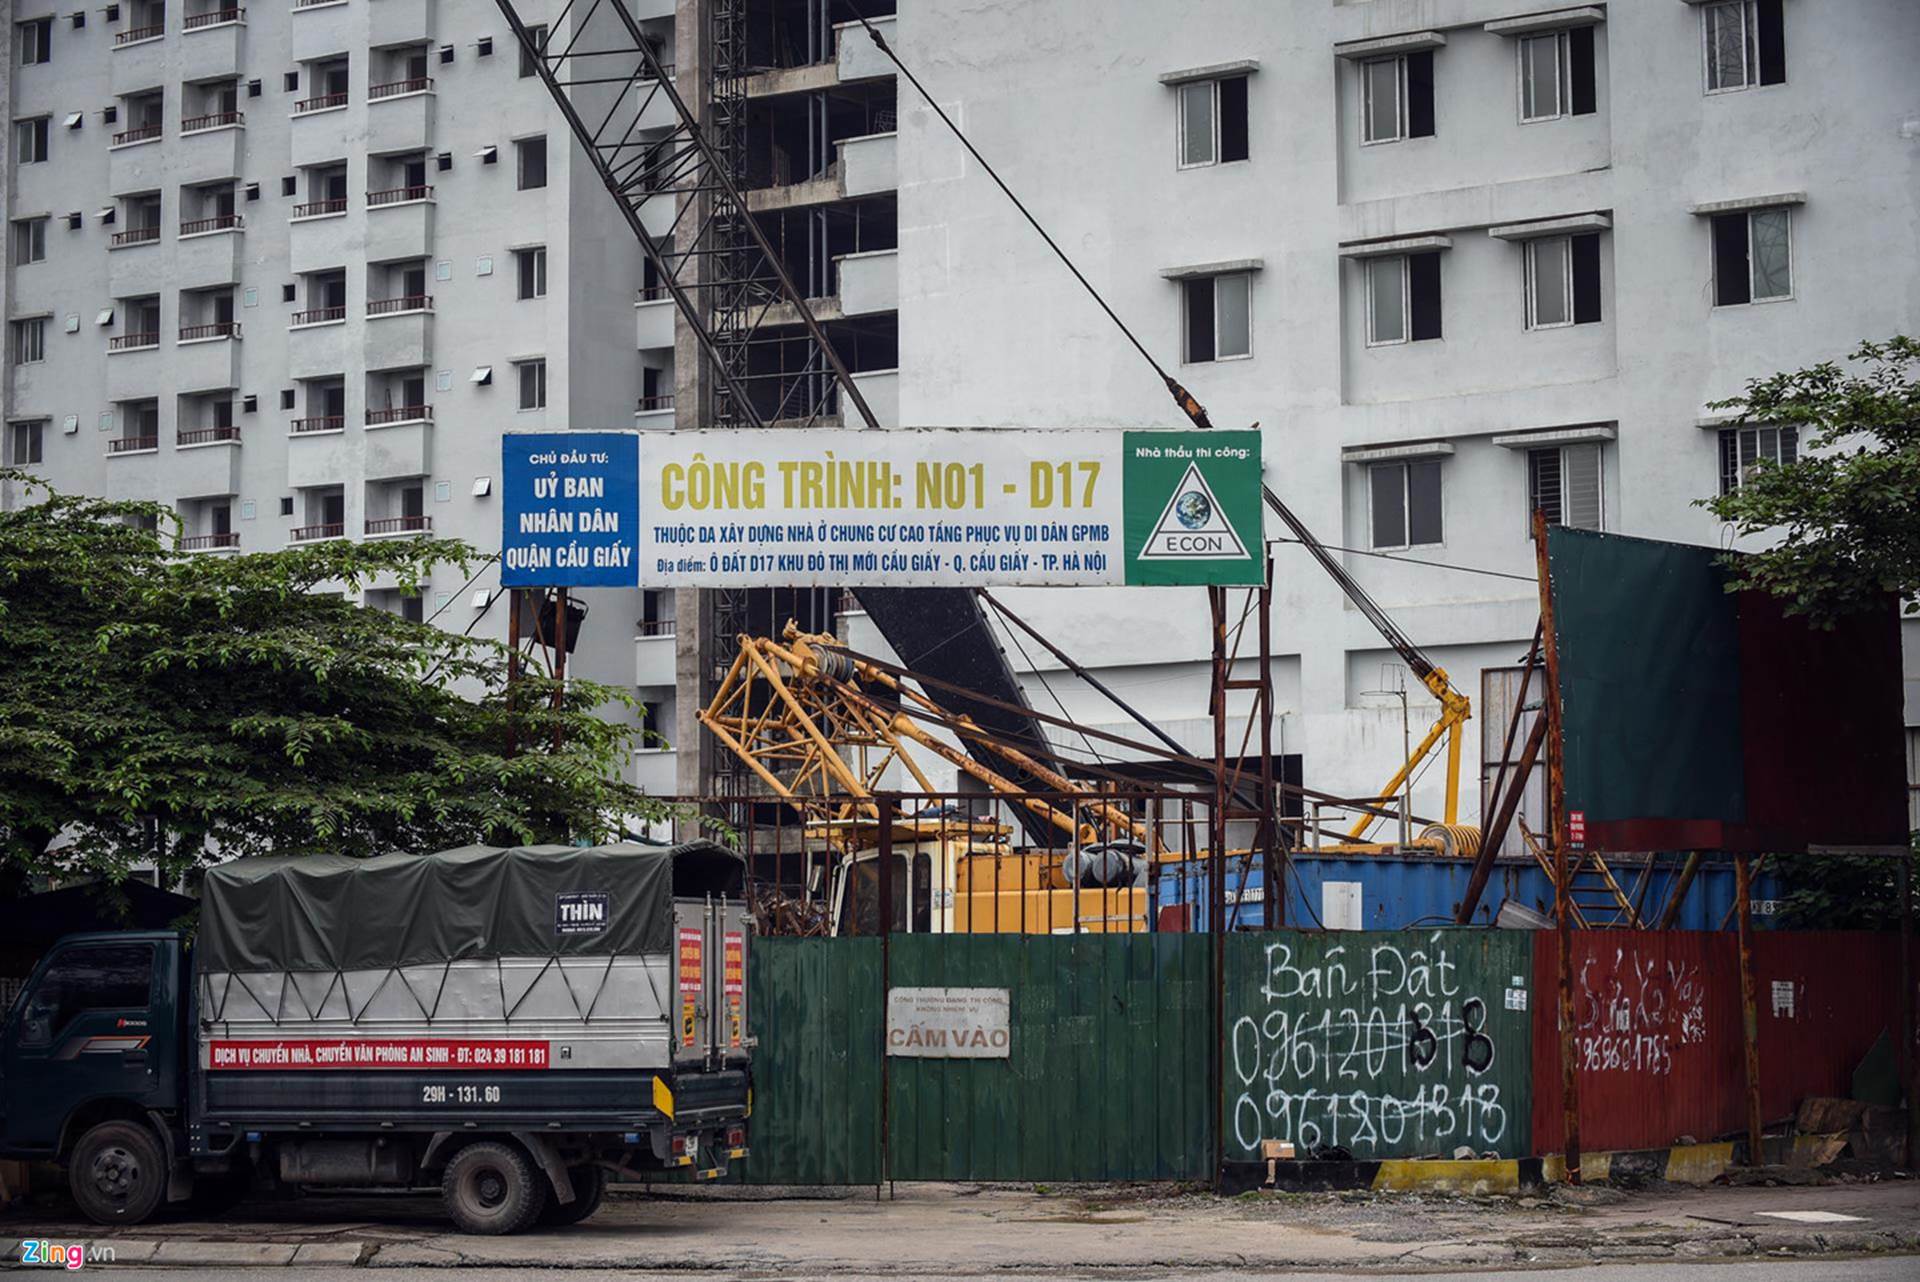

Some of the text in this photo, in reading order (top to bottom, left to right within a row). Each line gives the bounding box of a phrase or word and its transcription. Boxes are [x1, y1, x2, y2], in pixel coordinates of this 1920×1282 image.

[529, 450, 557, 465] CHỦ
[590, 452, 609, 464] TƯ:
[1136, 447, 1161, 457] Nhà
[1196, 448, 1211, 457] thi
[1215, 446, 1250, 459] công:
[534, 471, 604, 498] UỶ BAN
[661, 452, 766, 511] CÔNG
[777, 450, 902, 509] TRÌNH:
[1003, 484, 1016, 493] -
[1030, 461, 1100, 508] D17
[520, 508, 618, 533] NHÂN DÂN
[654, 523, 695, 547] THUỘC
[699, 526, 715, 543] DA
[720, 523, 744, 543] XÂY
[749, 525, 784, 546] DỰNG
[788, 522, 814, 542] NHÀ
[818, 520, 828, 542] Ở
[831, 525, 874, 542] CHUNG
[879, 523, 896, 542] CƯ
[900, 525, 924, 542] CAO
[966, 525, 1000, 546] PHỤC
[1004, 525, 1020, 546] VỤ
[1025, 525, 1037, 541] DI
[1042, 521, 1067, 541] DÂN
[1072, 525, 1109, 542] GPMB
[1167, 536, 1222, 551] ECON
[506, 544, 550, 572] QUẬN
[593, 540, 631, 567] GIẤY
[657, 557, 674, 575] Địa
[710, 552, 718, 572] Ô
[722, 549, 746, 571] ĐẤT
[751, 555, 774, 571] D17
[778, 555, 804, 571] KHU
[808, 551, 825, 571] ĐÔ
[829, 555, 848, 575] THỊ
[853, 550, 877, 571] MỚI
[911, 549, 940, 571] GIẤY
[954, 554, 966, 573] Q.
[1000, 549, 1029, 571] GIẤY
[1042, 554, 1058, 571] TP.
[1063, 551, 1079, 570] HÀ
[1085, 551, 1106, 575] NỘI
[560, 899, 603, 921] THÌN
[889, 1021, 1008, 1048] CẤM VÀO
[215, 1048, 236, 1067] DỊCH
[238, 1048, 251, 1067] VỤ
[354, 1043, 374, 1062] VĂN
[375, 1043, 408, 1062] PHÒNG
[410, 1047, 423, 1062] AN
[425, 1047, 449, 1062] SINH
[457, 1047, 472, 1062] ĐT:
[474, 1047, 492, 1062] 024
[494, 1048, 506, 1063] 39
[509, 1049, 526, 1063] 181
[529, 1049, 545, 1064] 181
[423, 1086, 446, 1102] 29H
